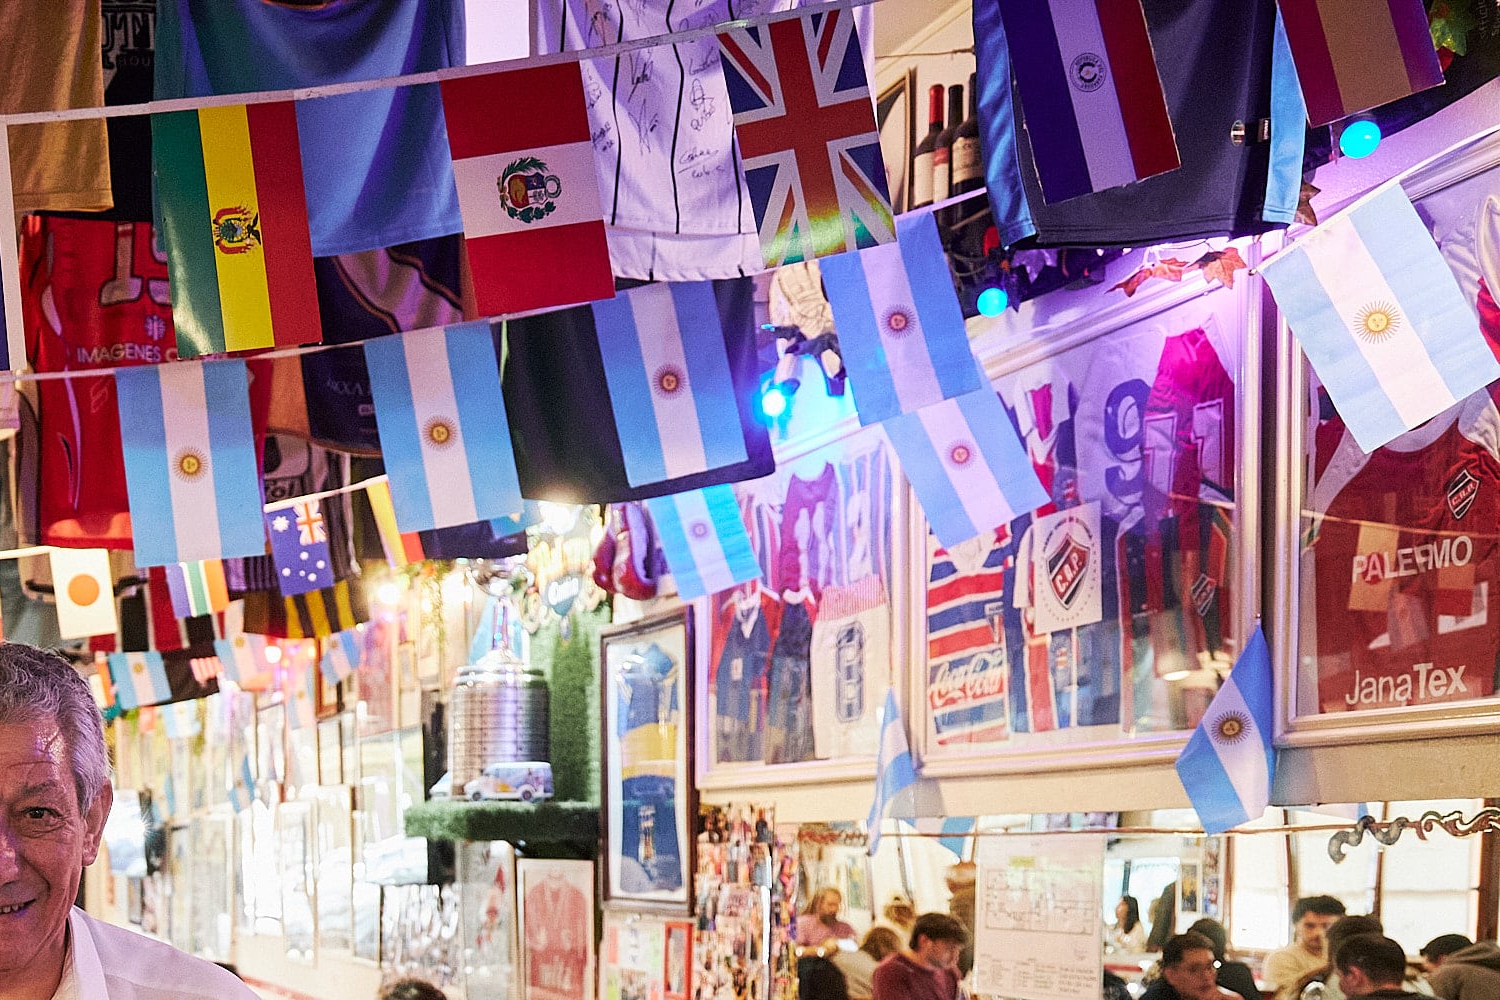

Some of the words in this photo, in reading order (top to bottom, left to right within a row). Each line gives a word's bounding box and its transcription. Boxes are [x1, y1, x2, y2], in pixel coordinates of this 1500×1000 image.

[77, 343, 162, 363] IMAGENES
[1104, 378, 1152, 500] 9
[1352, 535, 1473, 584] PALERMO
[1345, 662, 1468, 705] JanaTex
